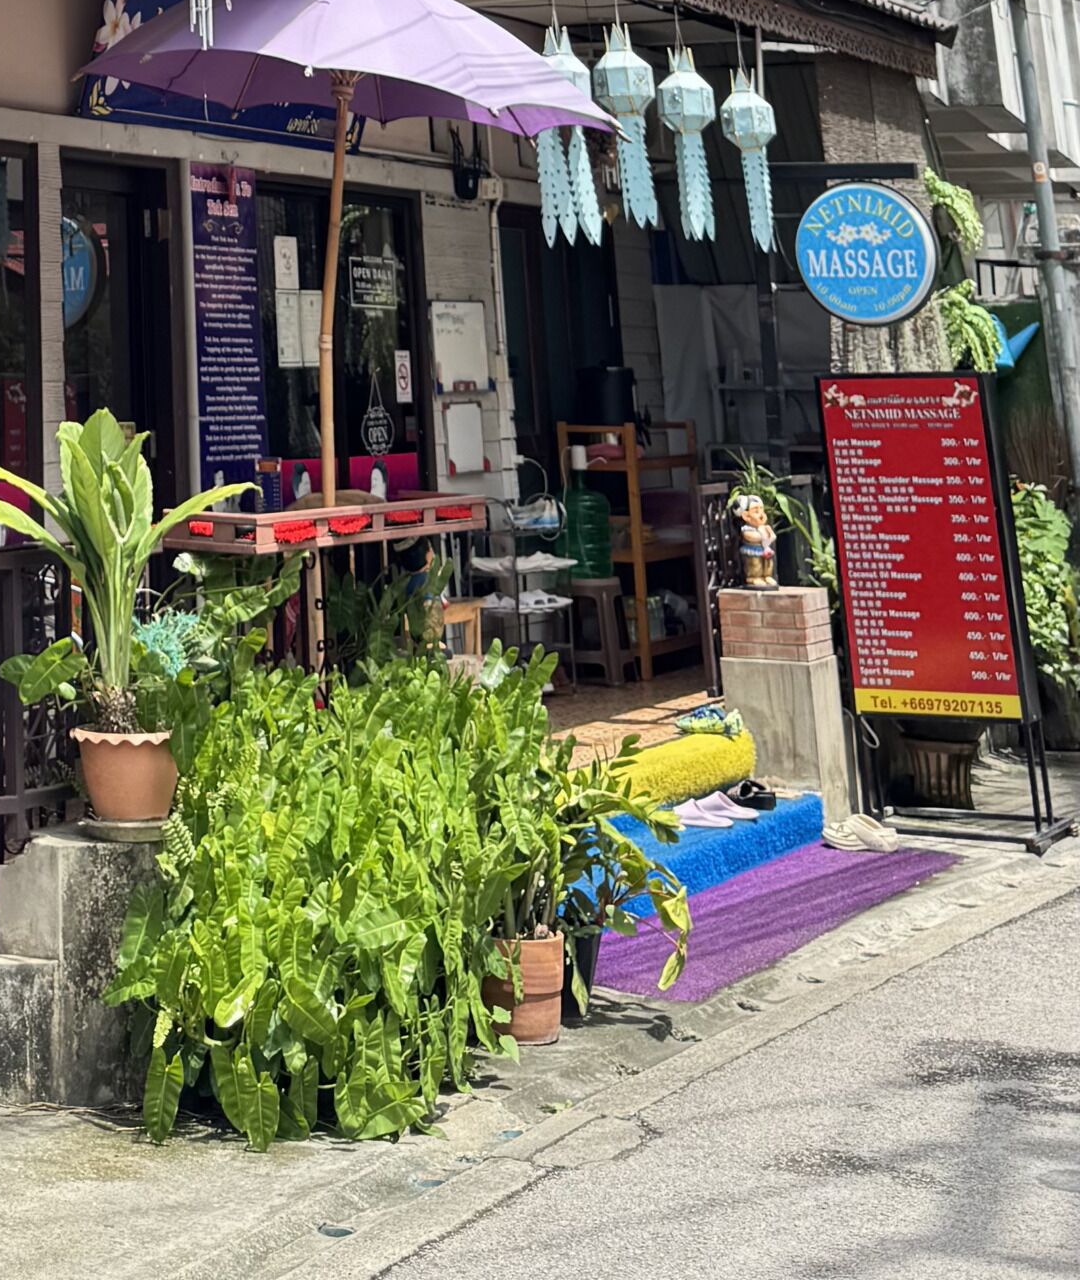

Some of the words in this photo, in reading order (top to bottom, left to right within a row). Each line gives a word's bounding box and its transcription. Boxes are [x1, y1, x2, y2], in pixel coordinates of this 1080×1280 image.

[805, 193, 914, 239] NETNIMID
[807, 249, 917, 278] MASSAGE
[848, 286, 878, 295] OPEN
[845, 409, 901, 419] NETNIMID
[905, 408, 960, 419] MASSAGE
[870, 695, 896, 709] Tel.
